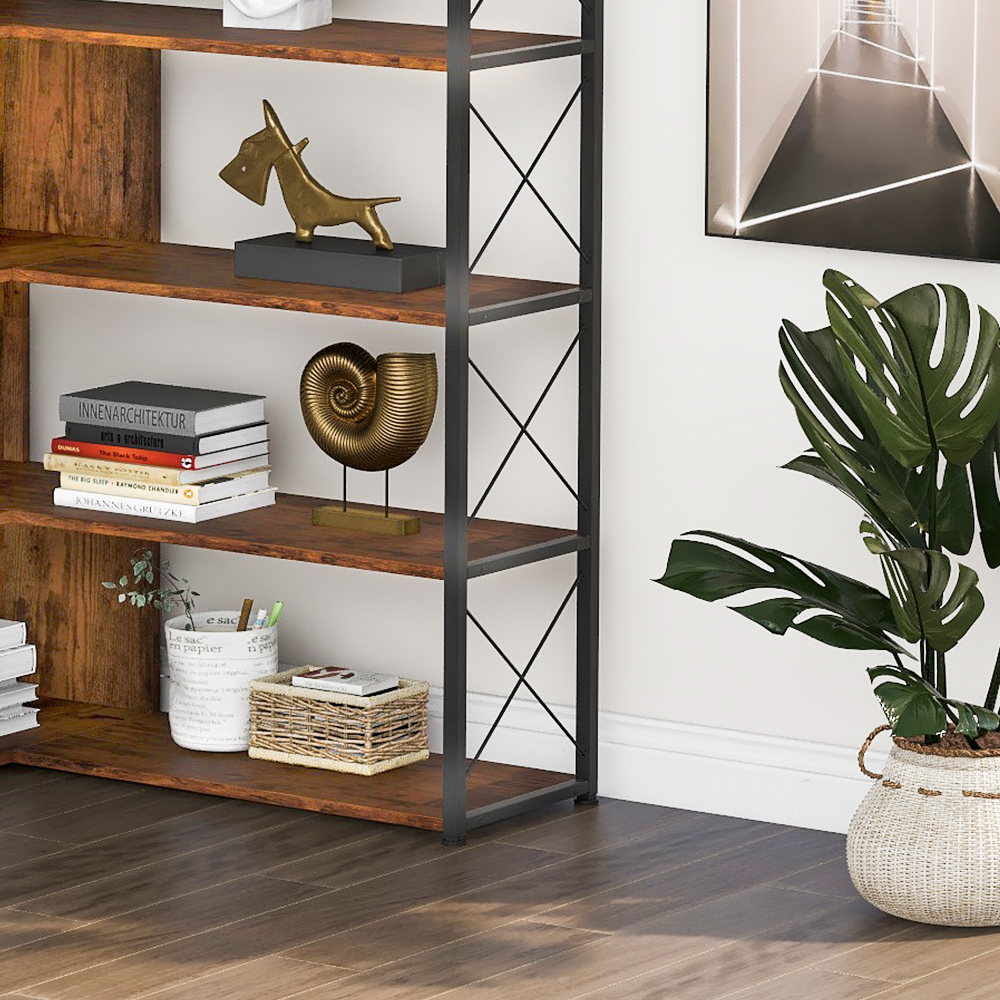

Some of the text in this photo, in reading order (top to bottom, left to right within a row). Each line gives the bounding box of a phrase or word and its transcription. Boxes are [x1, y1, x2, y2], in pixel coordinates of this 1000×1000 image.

[78, 401, 186, 430] INNENARCHITEKTUR
[57, 444, 80, 453] DUMAS
[112, 451, 131, 460] Black
[80, 476, 91, 484] BIG
[92, 478, 109, 486] SLEEP
[116, 481, 146, 491] RAYMOND
[148, 485, 179, 495] CHANDLER
[184, 644, 224, 655] papier
